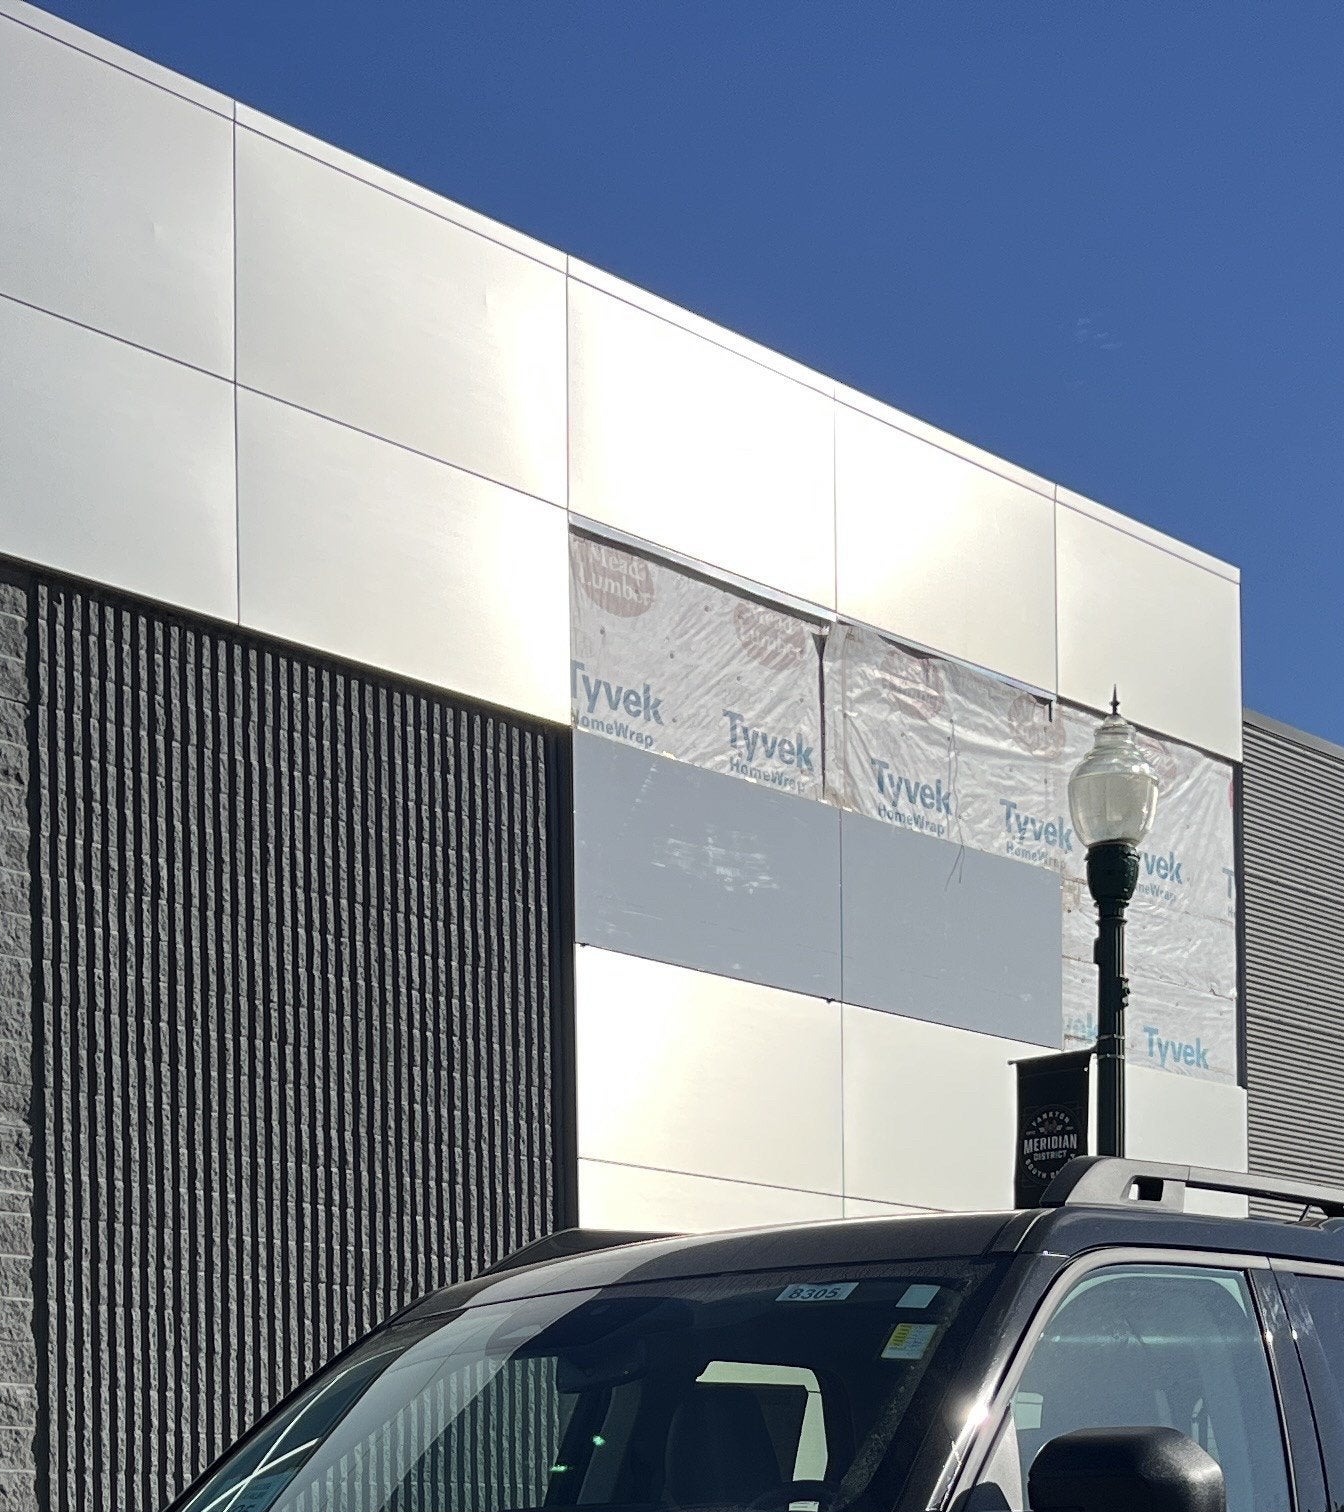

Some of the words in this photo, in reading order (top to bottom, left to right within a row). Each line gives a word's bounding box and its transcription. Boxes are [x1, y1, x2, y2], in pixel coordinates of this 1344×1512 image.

[570, 658, 664, 726] Tyvek
[723, 709, 816, 772] Tyvek
[870, 757, 954, 816] Tyvek
[877, 804, 946, 836] HomeWrap
[999, 798, 1074, 853] Tyvek
[1141, 851, 1183, 884] vek
[1143, 1025, 1210, 1070] Tyvek
[1023, 1133, 1077, 1155] MERIDIAN
[1033, 1150, 1067, 1161] DISTRICT
[788, 1287, 841, 1300] 8305
